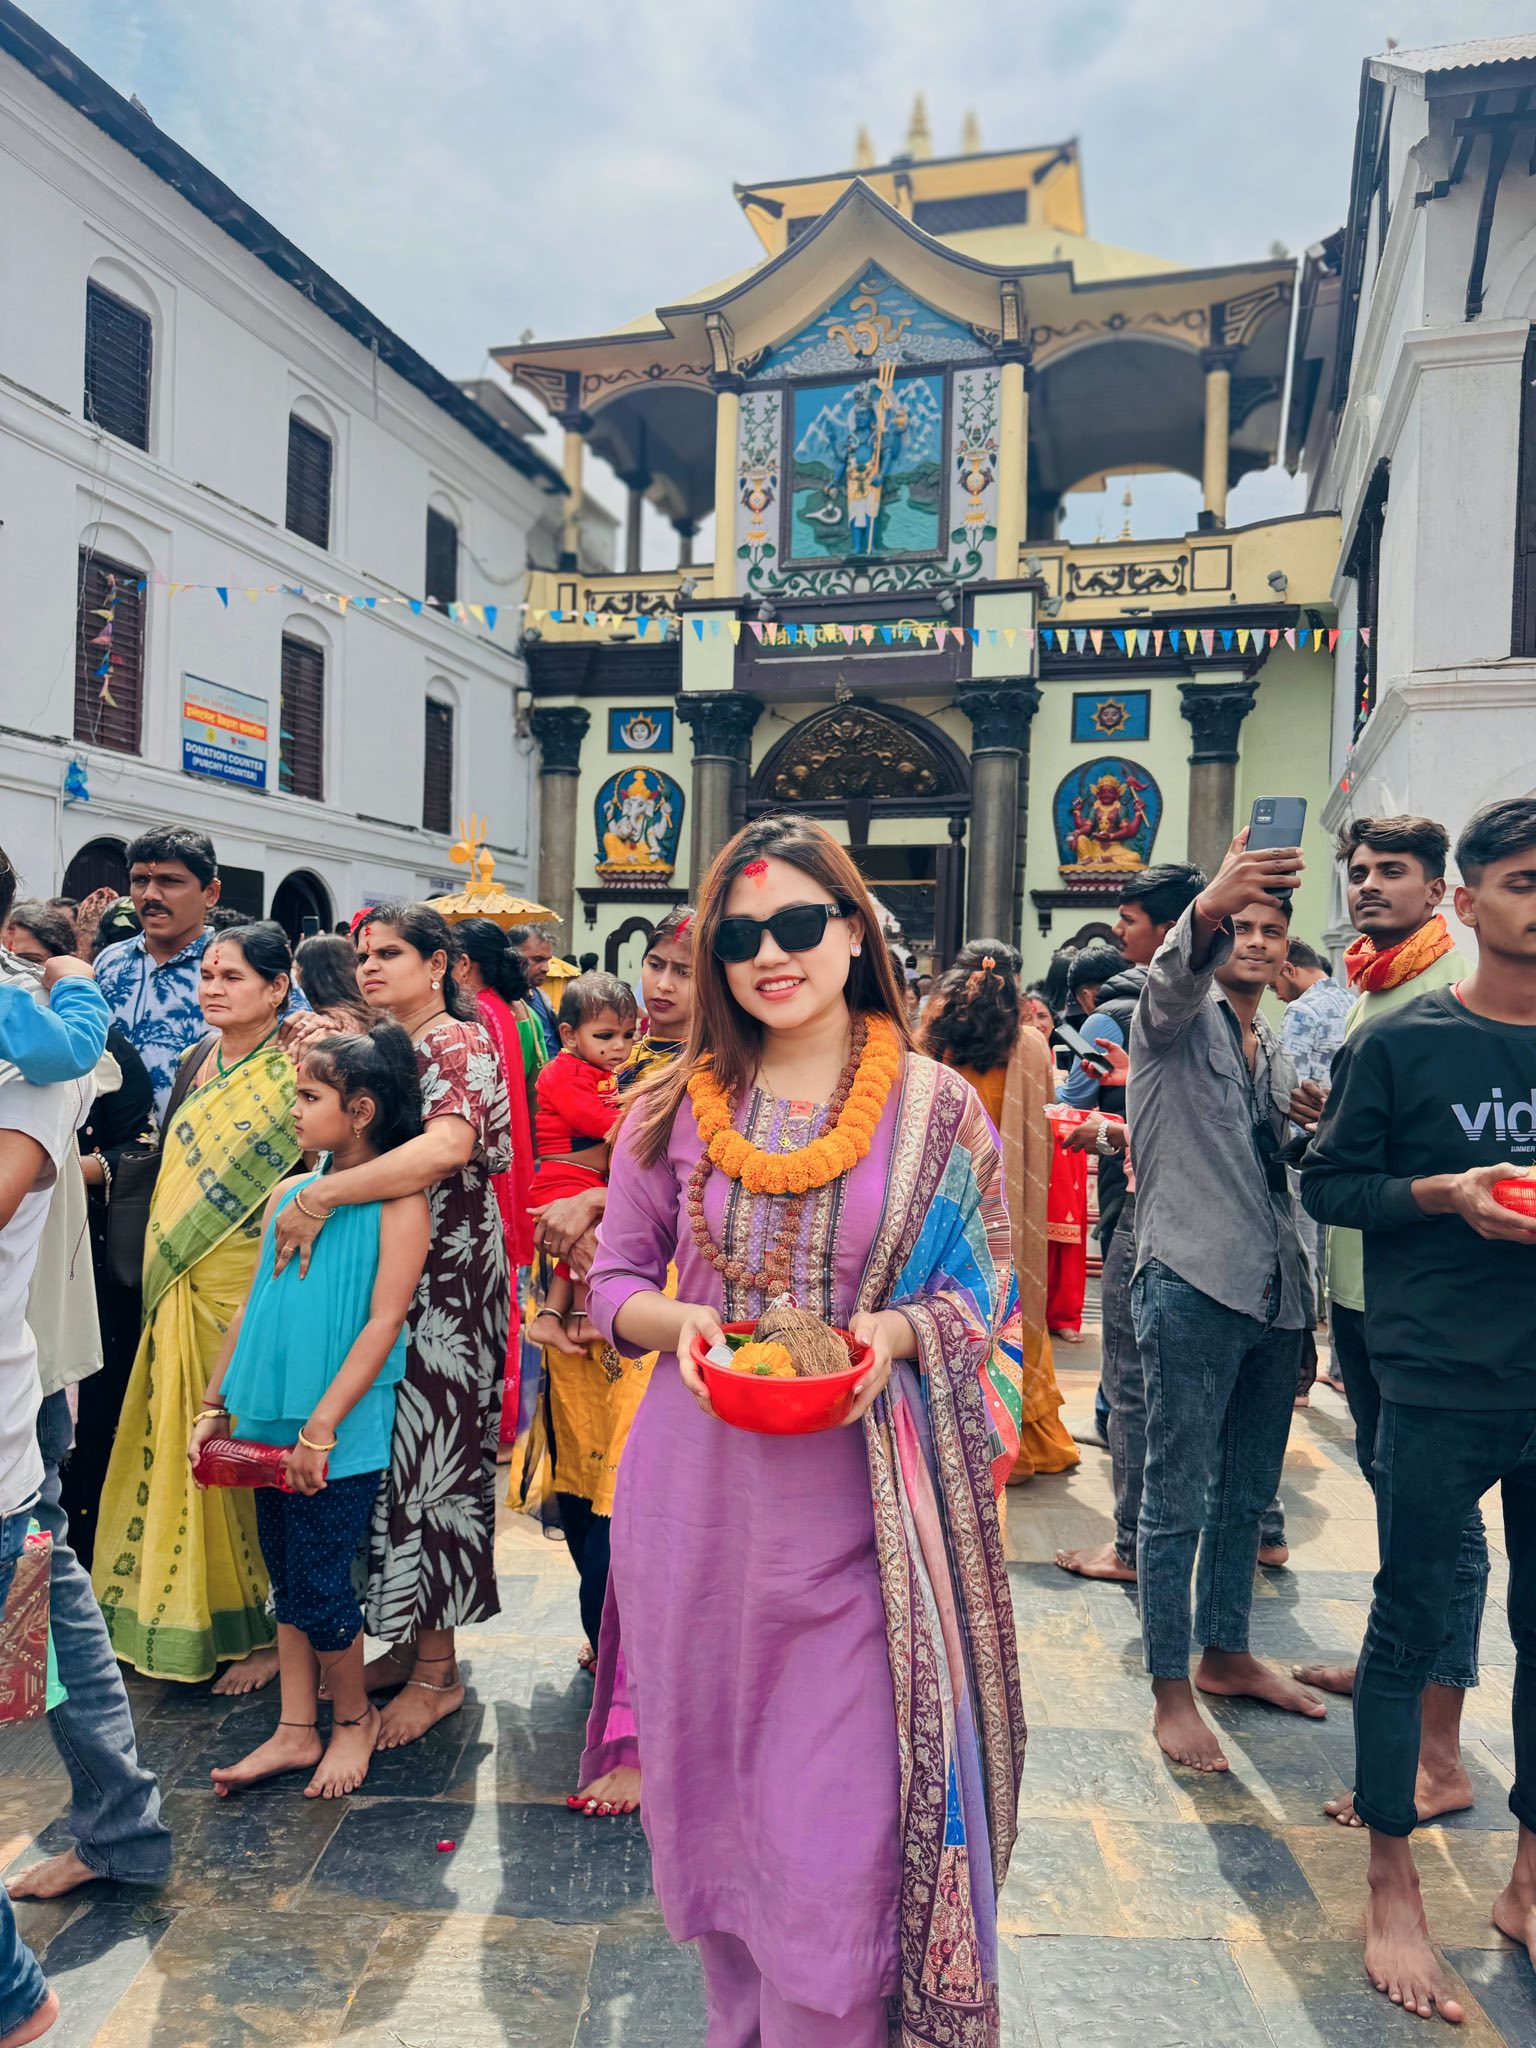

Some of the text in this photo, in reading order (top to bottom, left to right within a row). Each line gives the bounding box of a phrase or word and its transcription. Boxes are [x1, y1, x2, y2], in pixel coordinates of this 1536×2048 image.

[185, 742, 227, 761] DONATION
[228, 754, 264, 772] COUNTER
[224, 765, 257, 781] COUNTER)
[1510, 1145, 1536, 1153] SUMMER
